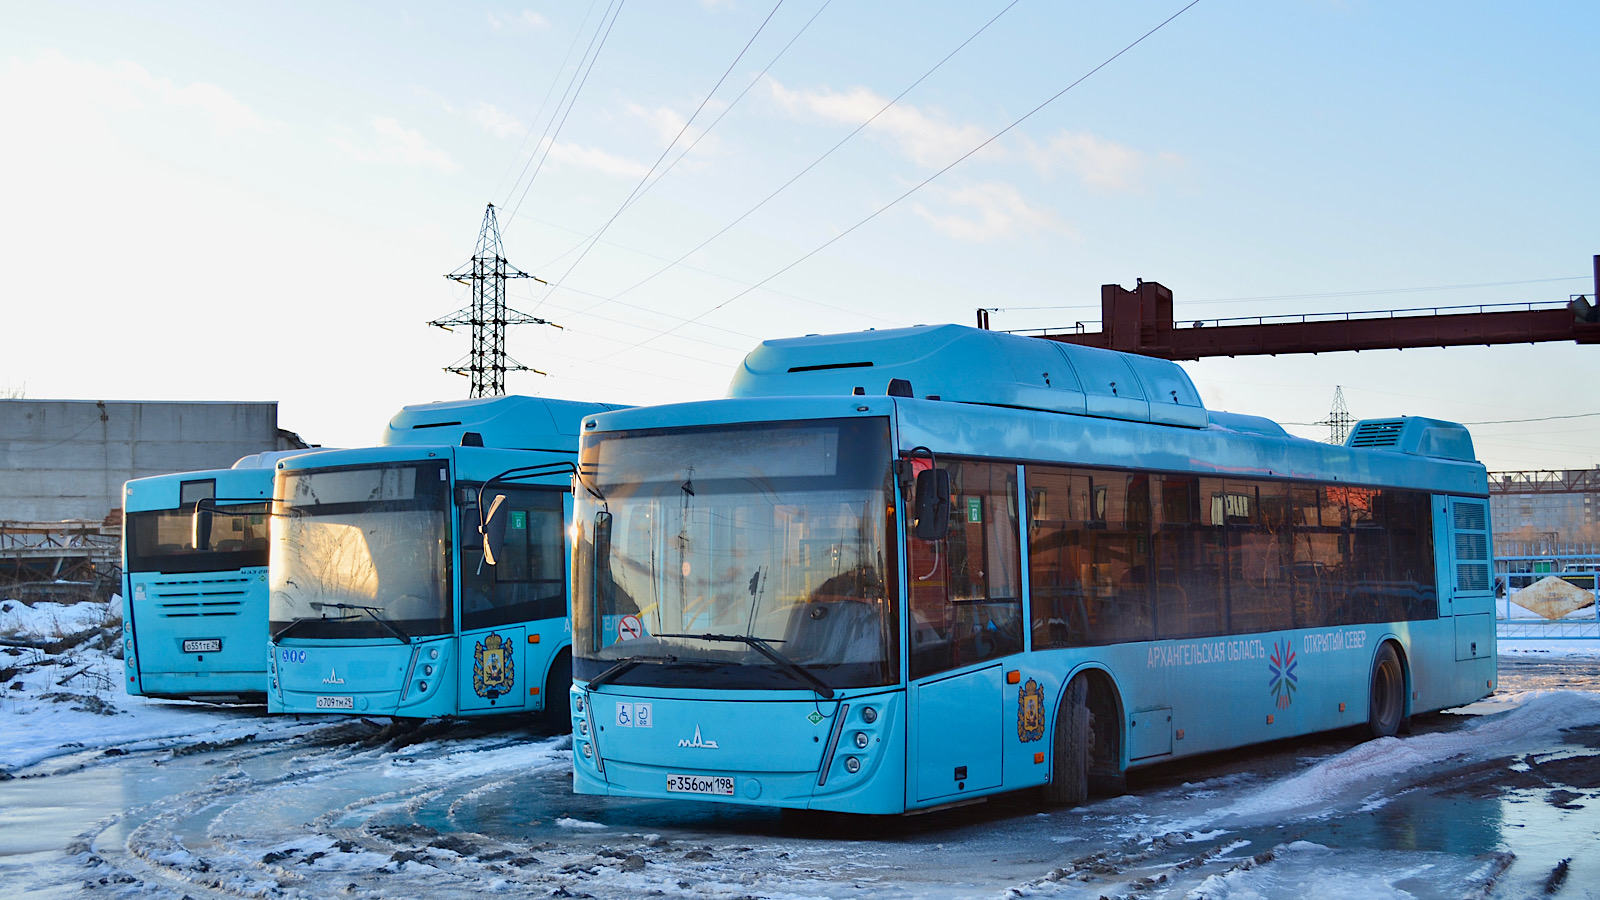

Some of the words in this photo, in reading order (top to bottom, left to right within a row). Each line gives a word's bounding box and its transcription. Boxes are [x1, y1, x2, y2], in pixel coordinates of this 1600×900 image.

[1147, 642, 1225, 669] АРХАНГЕЛЬСКАЯ
[1227, 639, 1265, 661] ОБЛАСТЬ
[1303, 628, 1344, 654] ОТКРЫТЫЙ
[1345, 630, 1367, 649] СЕВЕР
[715, 778, 731, 789] 198
